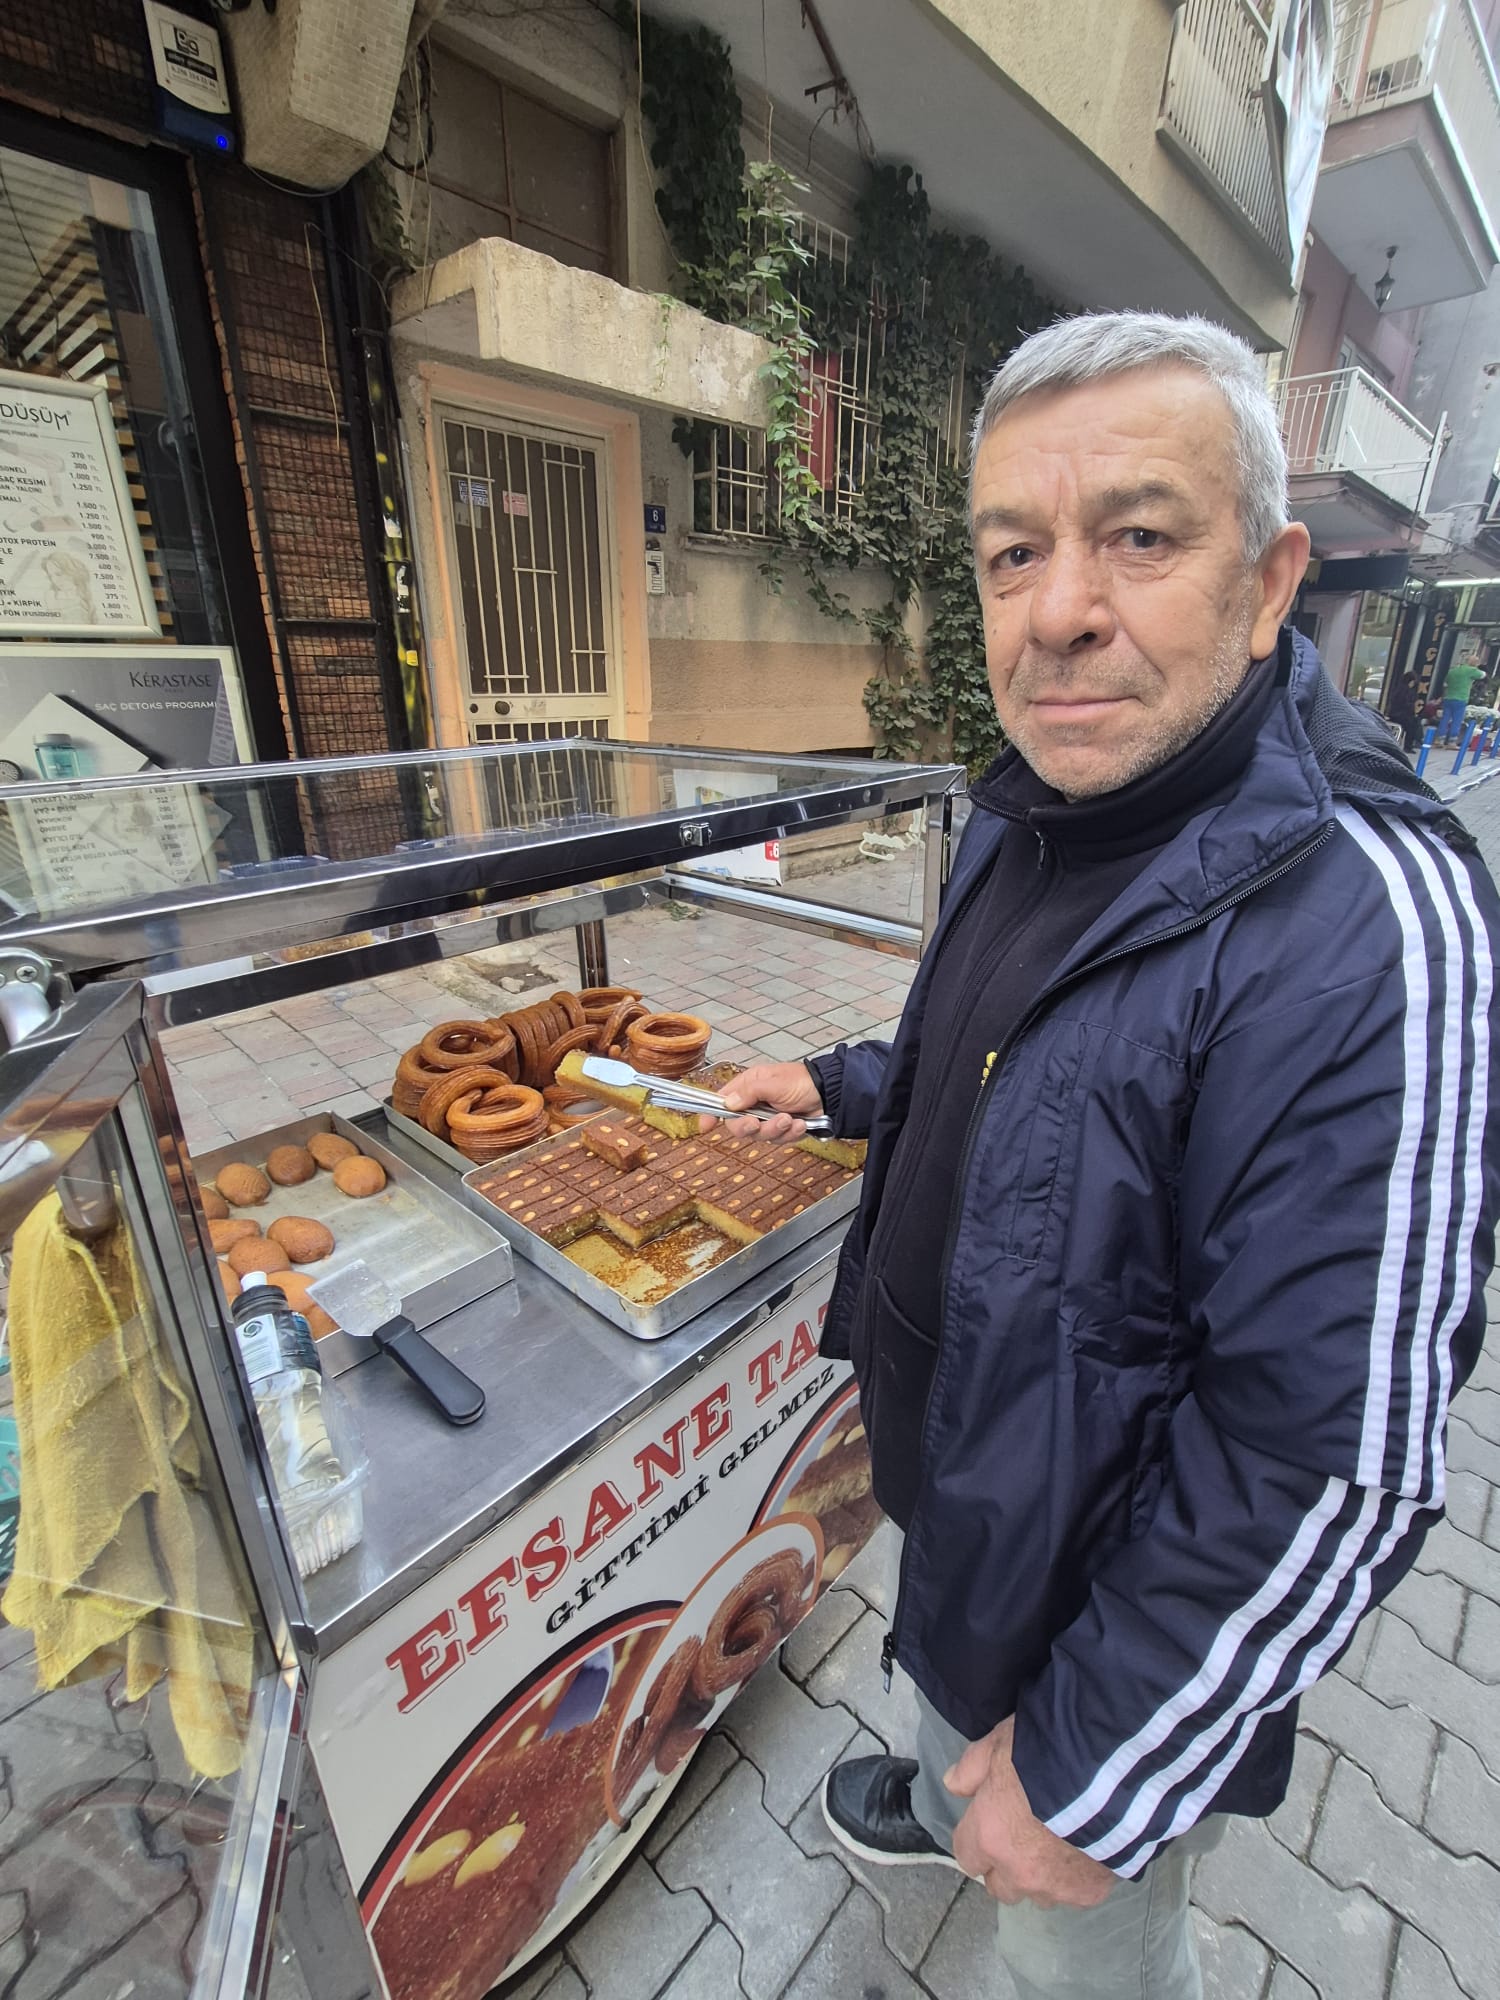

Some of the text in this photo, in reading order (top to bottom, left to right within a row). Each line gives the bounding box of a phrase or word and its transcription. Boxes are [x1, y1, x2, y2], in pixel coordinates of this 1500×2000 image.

[652, 509, 659, 522] 6
[129, 671, 213, 688] KÉRASTASE
[95, 702, 117, 712] SAÇ
[120, 701, 164, 710] DETOKS
[545, 1363, 835, 1636] GİTTİMİ GELMEZ
[385, 1382, 732, 1715] EFSANE
